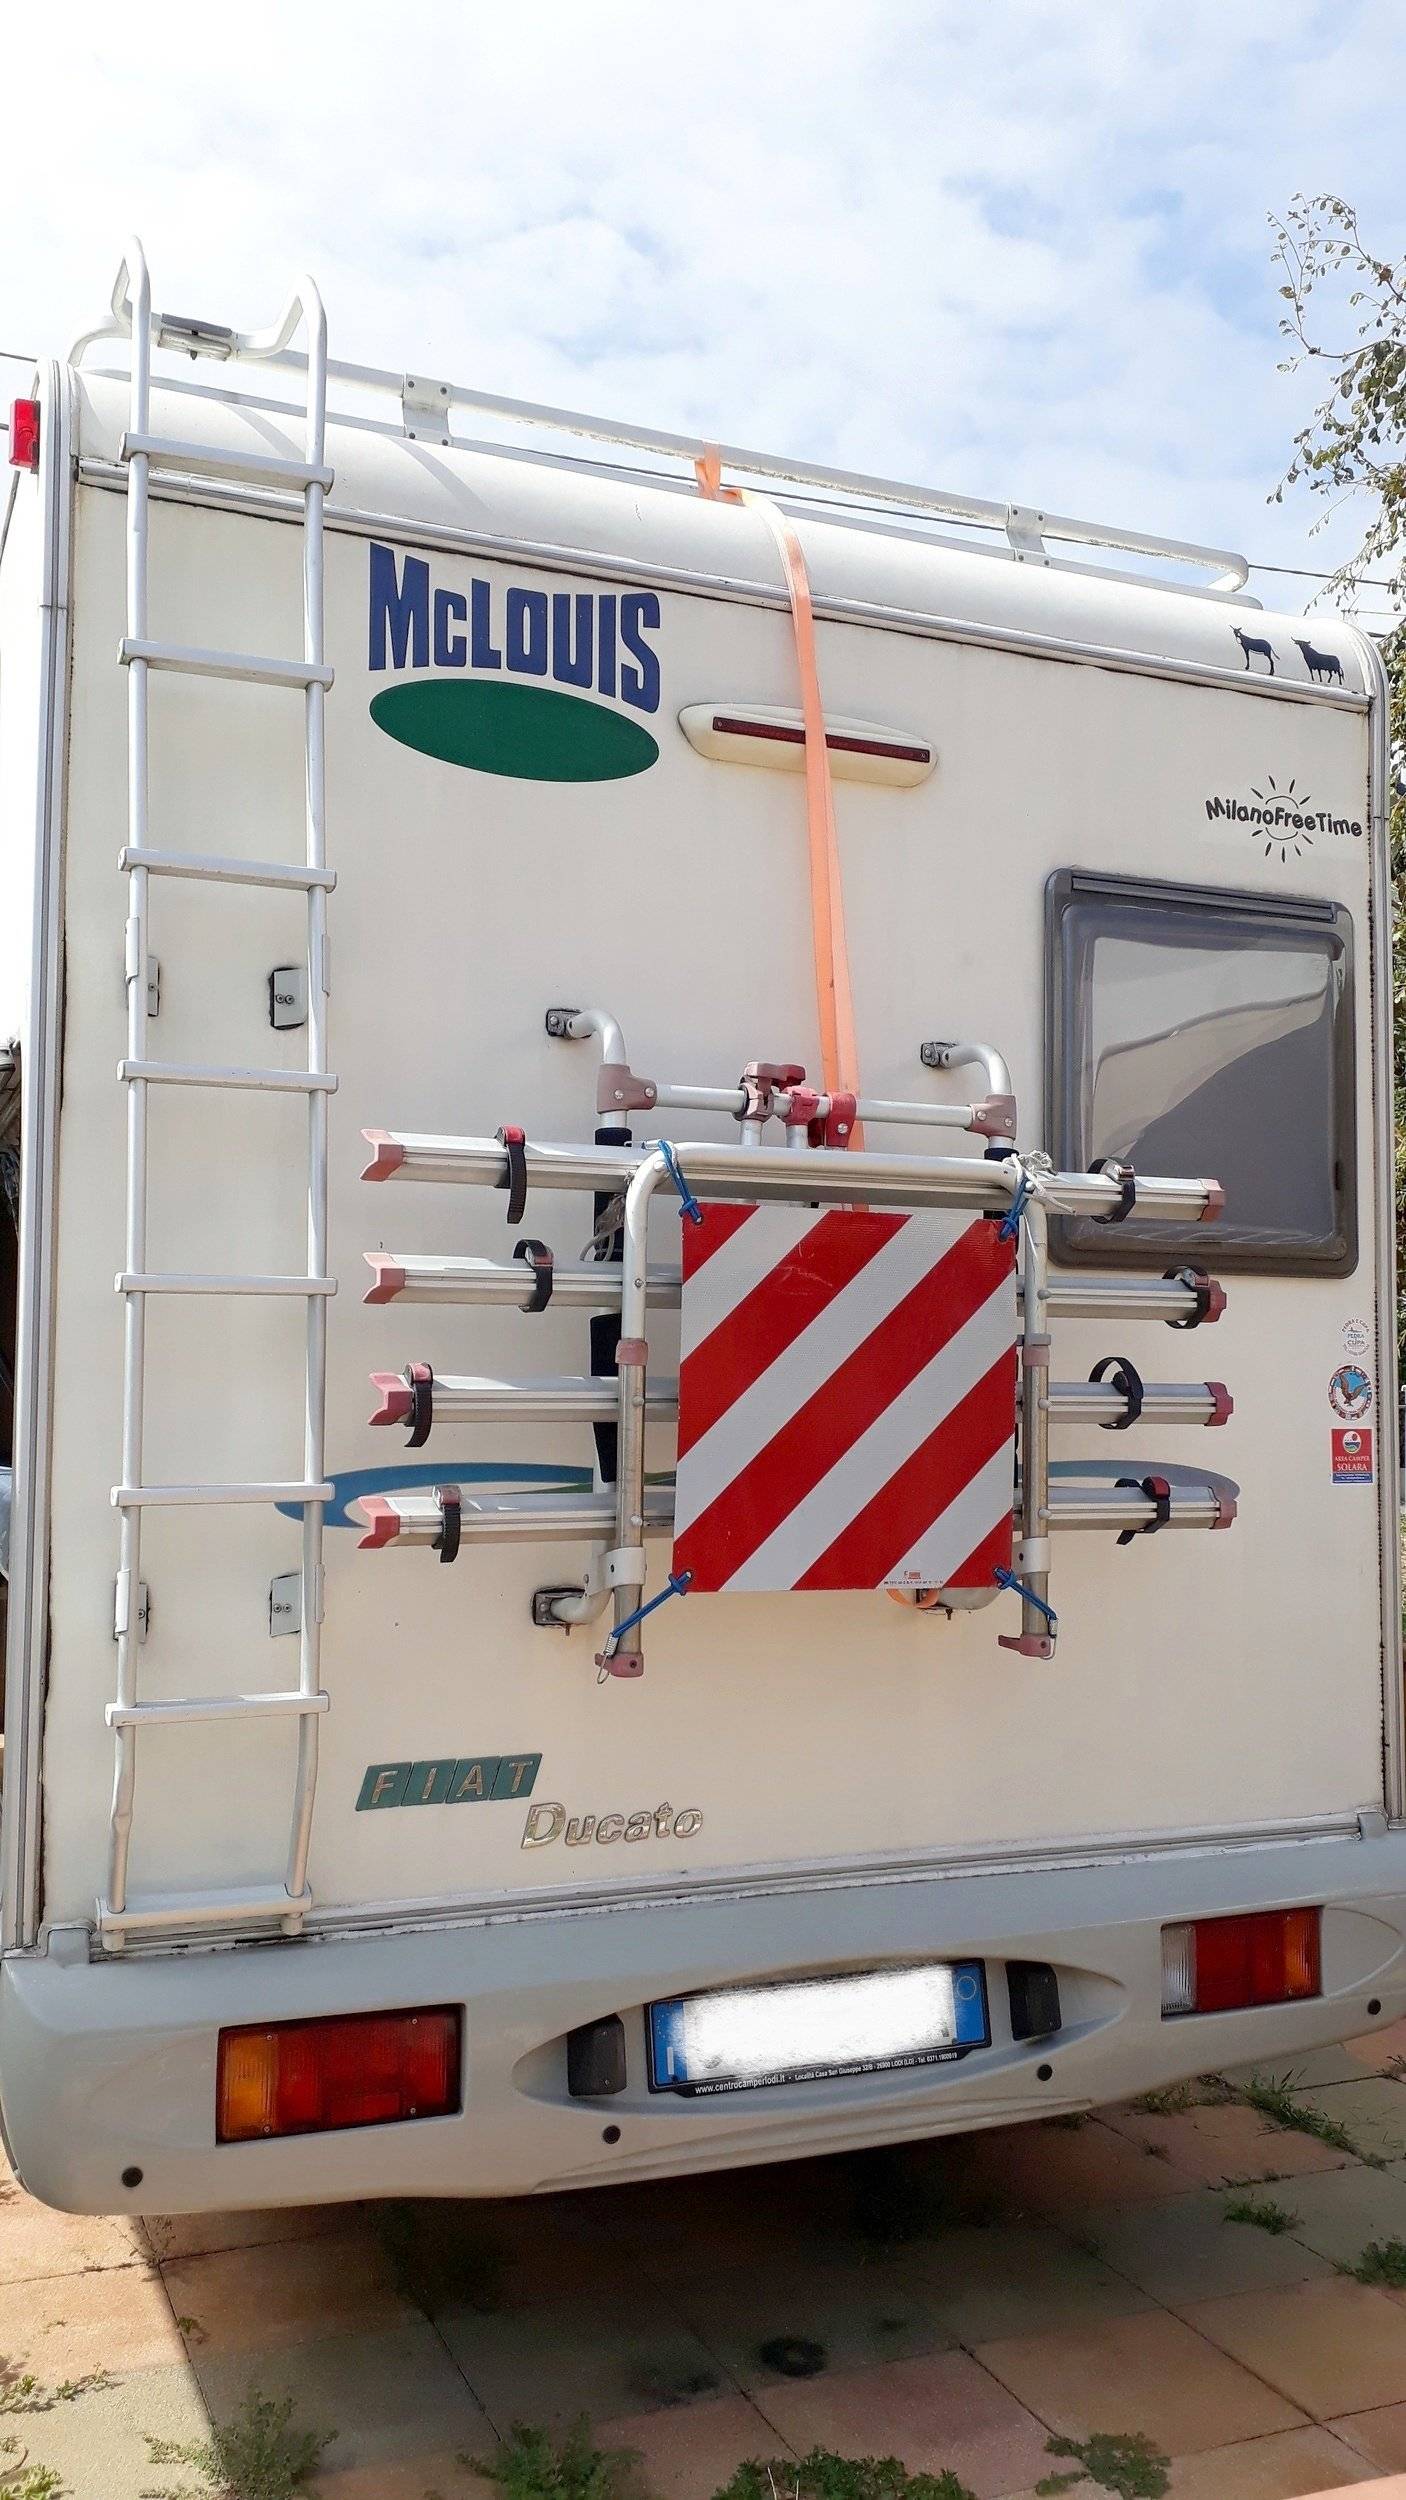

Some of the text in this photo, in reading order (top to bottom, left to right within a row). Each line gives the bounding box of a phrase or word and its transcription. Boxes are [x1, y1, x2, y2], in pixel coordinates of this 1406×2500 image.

[1205, 796, 1363, 837] MilanoFreeTime
[1336, 1462, 1368, 1471] SOLARA
[370, 1759, 534, 1803] FIAT
[520, 1801, 704, 1849] Ducato
